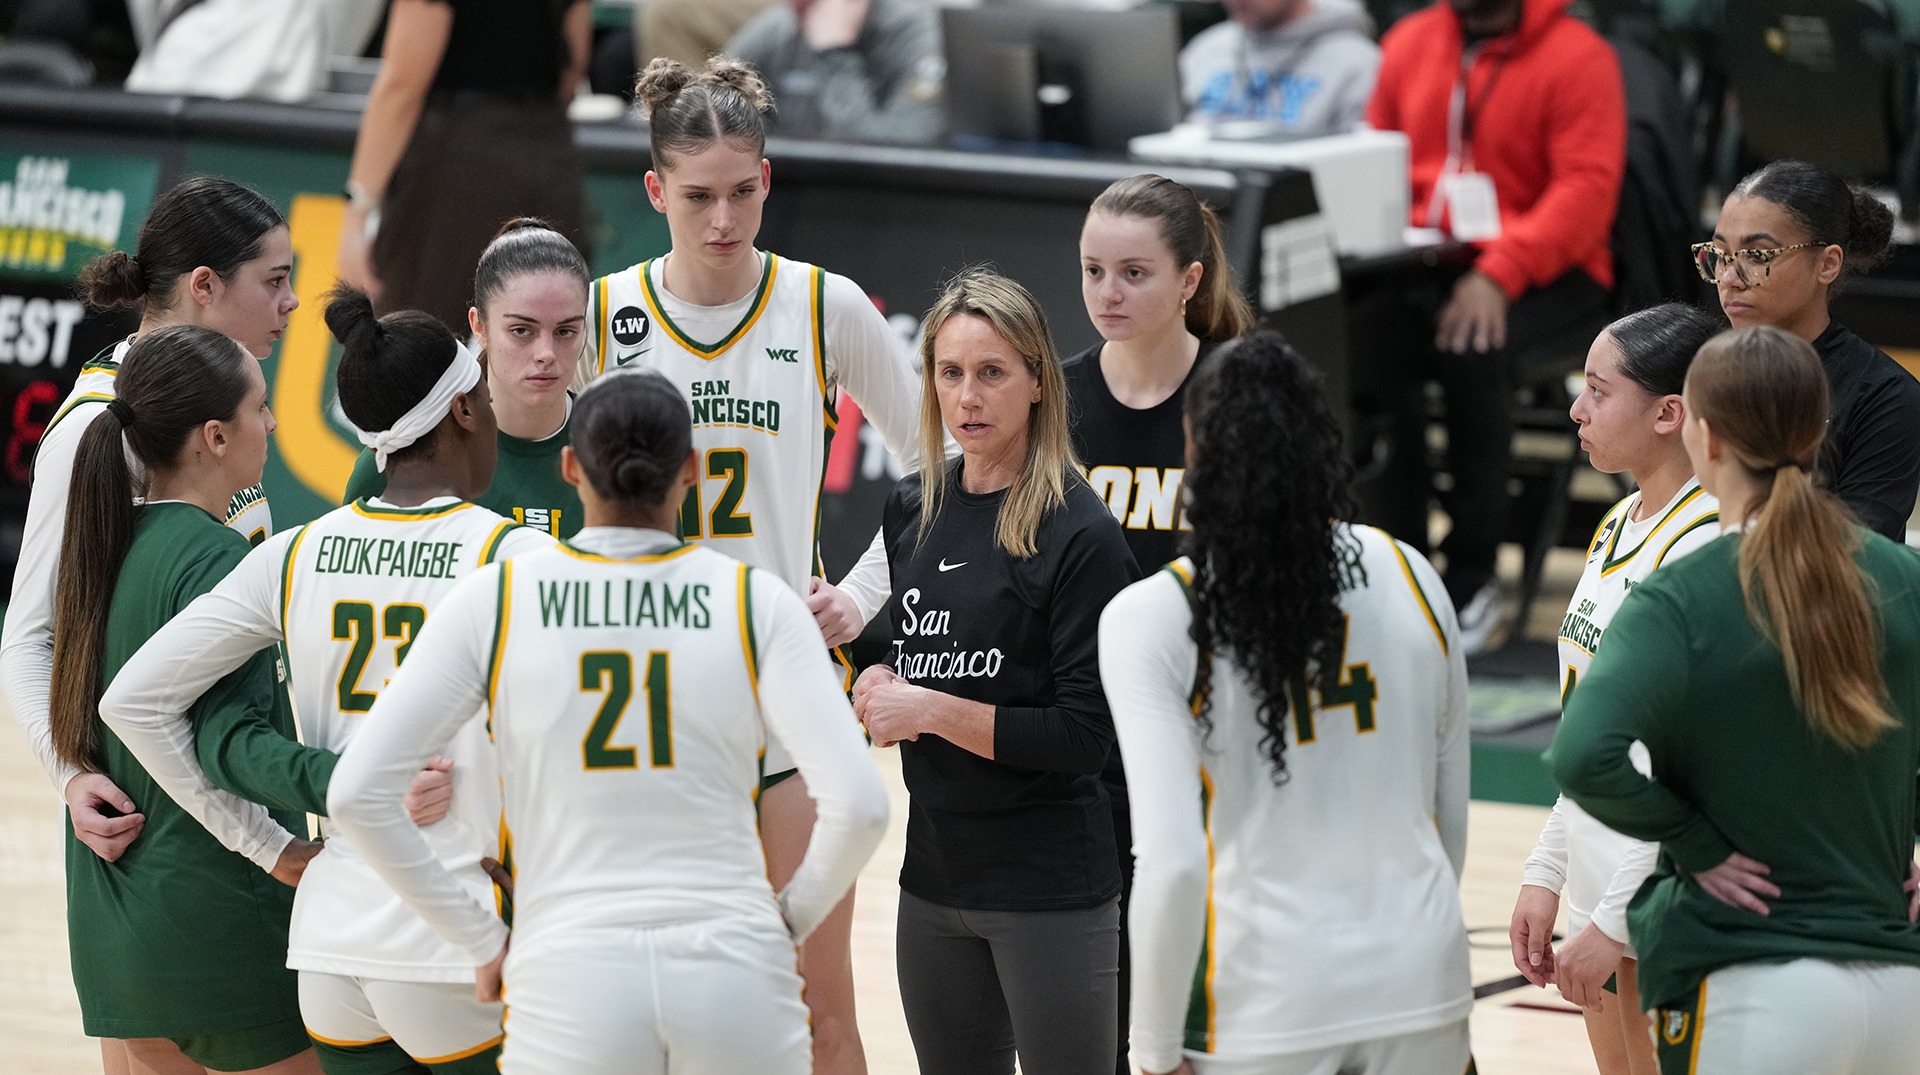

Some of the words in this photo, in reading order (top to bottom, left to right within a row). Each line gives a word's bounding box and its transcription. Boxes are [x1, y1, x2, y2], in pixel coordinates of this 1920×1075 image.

[615, 317, 645, 334] LW
[765, 347, 799, 363] WCC
[691, 380, 730, 397] SAN
[315, 535, 463, 578] EDOKPAIGBE
[539, 580, 711, 628] WILLIAMS
[902, 588, 950, 636] San
[1577, 598, 1597, 617] SAN
[893, 639, 1005, 680] Francisco
[579, 649, 675, 772] 21
